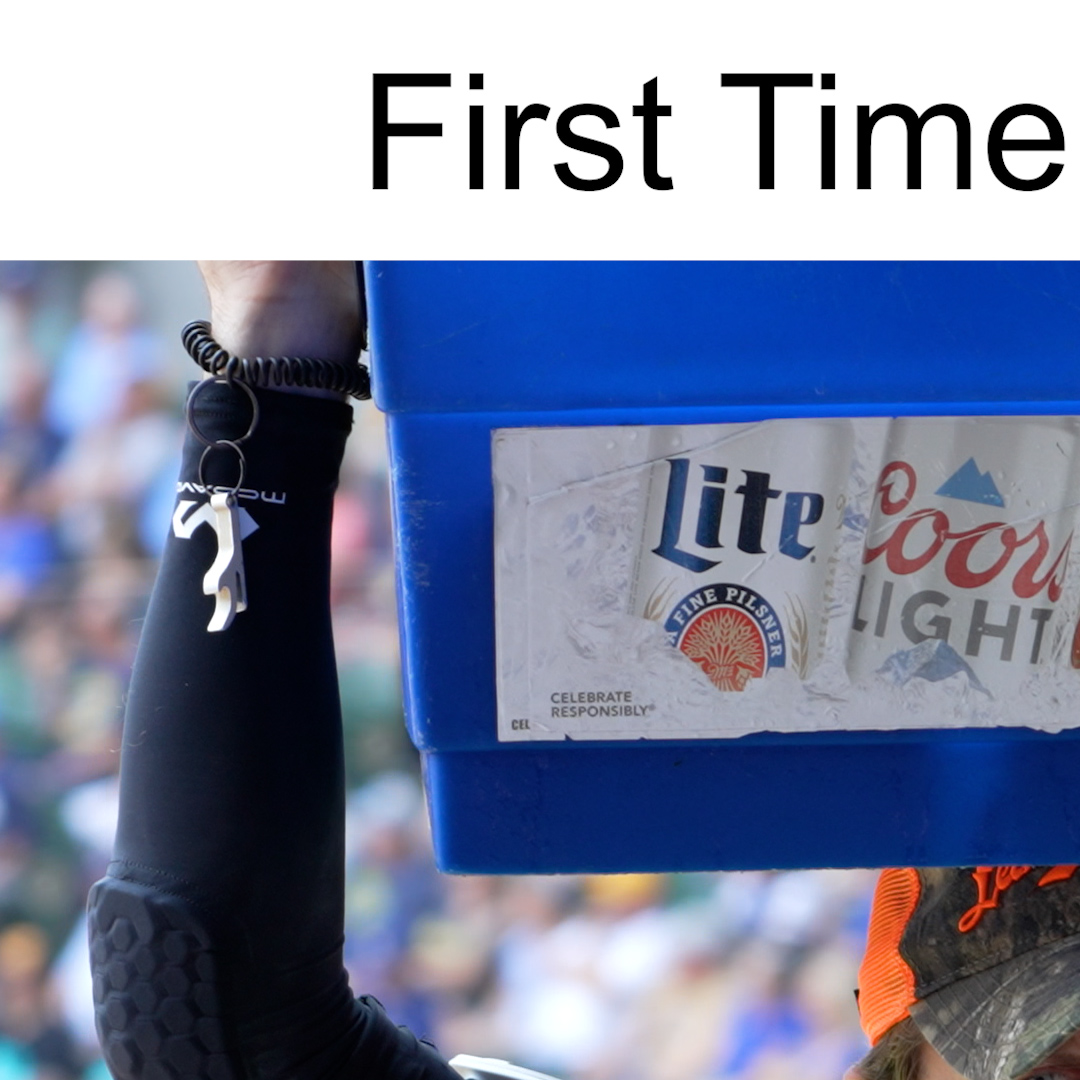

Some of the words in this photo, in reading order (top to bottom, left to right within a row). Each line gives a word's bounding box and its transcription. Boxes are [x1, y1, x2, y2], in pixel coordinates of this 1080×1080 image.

[652, 458, 825, 573] Lite
[672, 588, 718, 626] FINE
[724, 586, 783, 659] PILSNER
[852, 574, 1054, 665] LIGHT
[551, 691, 633, 704] CELEBRATE
